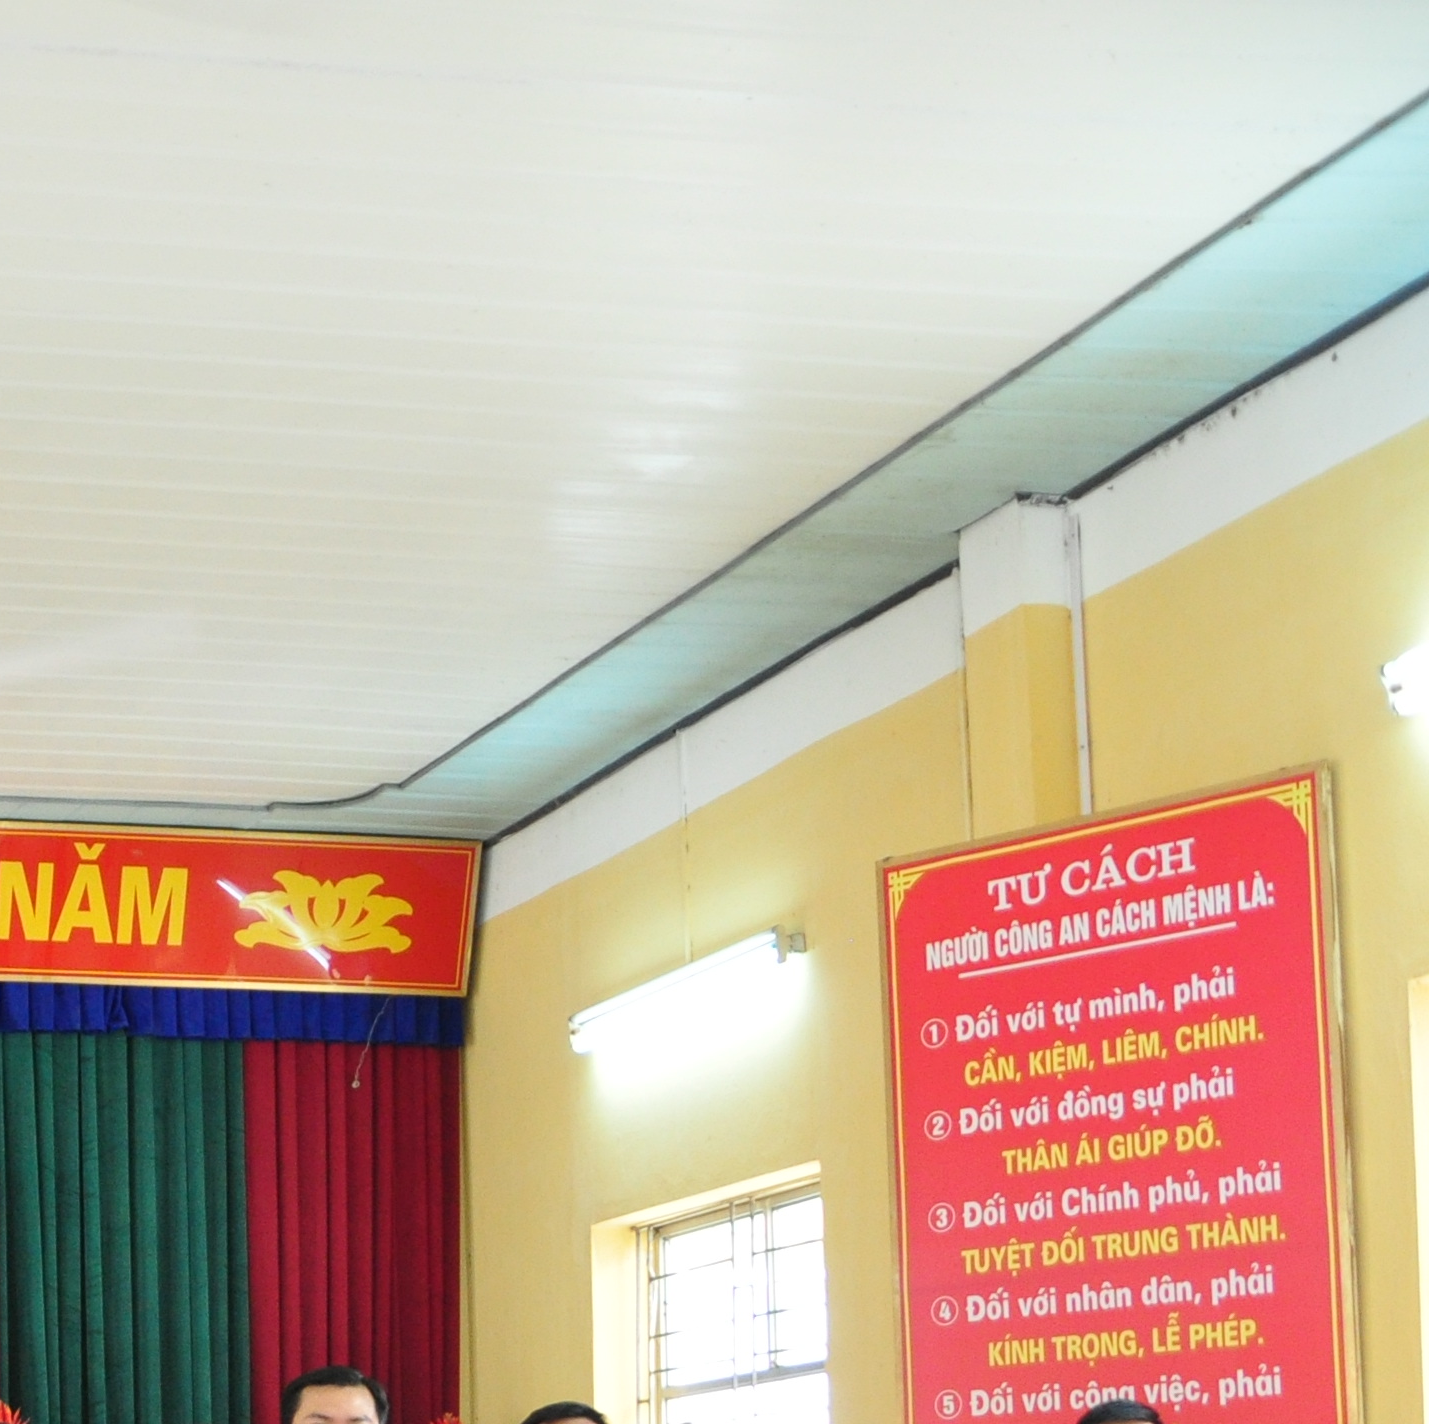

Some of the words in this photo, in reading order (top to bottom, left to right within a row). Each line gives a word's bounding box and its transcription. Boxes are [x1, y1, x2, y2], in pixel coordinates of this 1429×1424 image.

[988, 864, 1051, 910] TƯ
[1062, 838, 1195, 895] CÁCH
[926, 927, 989, 971] NGƯỜI
[995, 920, 1053, 957] CÔNG
[1060, 912, 1090, 945] AN
[1096, 899, 1156, 937] CÁCH
[1163, 884, 1231, 926] MỆNH
[1238, 871, 1274, 910] LÀ:
[956, 1006, 998, 1041] Đối
[1007, 1002, 1045, 1032] với
[1053, 999, 1082, 1031] tự
[1090, 984, 1164, 1019] mình,
[1174, 966, 1235, 1011] phải
[965, 1048, 1021, 1086] CẦN,
[1030, 1041, 1094, 1078] KIỆM,
[1103, 1029, 1167, 1064] LIÊM,
[1176, 1015, 1263, 1052] CHÍNH.
[959, 1099, 1002, 1134] Đối
[1011, 1097, 1049, 1127] với
[1058, 1086, 1124, 1120] đồng
[1133, 1082, 1165, 1115] sự
[1174, 1066, 1234, 1110] phải
[1002, 1140, 1068, 1174] THÂN
[1076, 1133, 1100, 1165] ÁI
[1108, 1125, 1169, 1160] GIÚP
[1176, 1116, 1221, 1152] ĐỠ.
[963, 1193, 1006, 1228] Đối
[1015, 1192, 1053, 1222] với
[1062, 1182, 1139, 1216] Chính
[1149, 1170, 1209, 1213] phủ,
[1219, 1160, 1281, 1204] phải
[962, 1239, 1035, 1276] TUYỆT
[1042, 1227, 1085, 1266] ĐỐI
[1092, 1226, 1179, 1259] TRUNG
[1186, 1214, 1285, 1249] THÀNH.
[966, 1288, 1009, 1322] Đối
[1019, 1288, 1057, 1317] với
[1066, 1282, 1132, 1312] nhân
[1142, 1275, 1201, 1305] dân,
[1211, 1263, 1273, 1305] phải
[989, 1335, 1045, 1366] KÍNH
[1052, 1330, 1144, 1366] TRỌNG,
[1153, 1313, 1181, 1353] LỄ
[1189, 1314, 1263, 1349] PHÉP.
[970, 1382, 1013, 1416] Đối
[1022, 1384, 1061, 1413] với
[1144, 1374, 1209, 1411] việc,
[1219, 1364, 1282, 1406] phải
